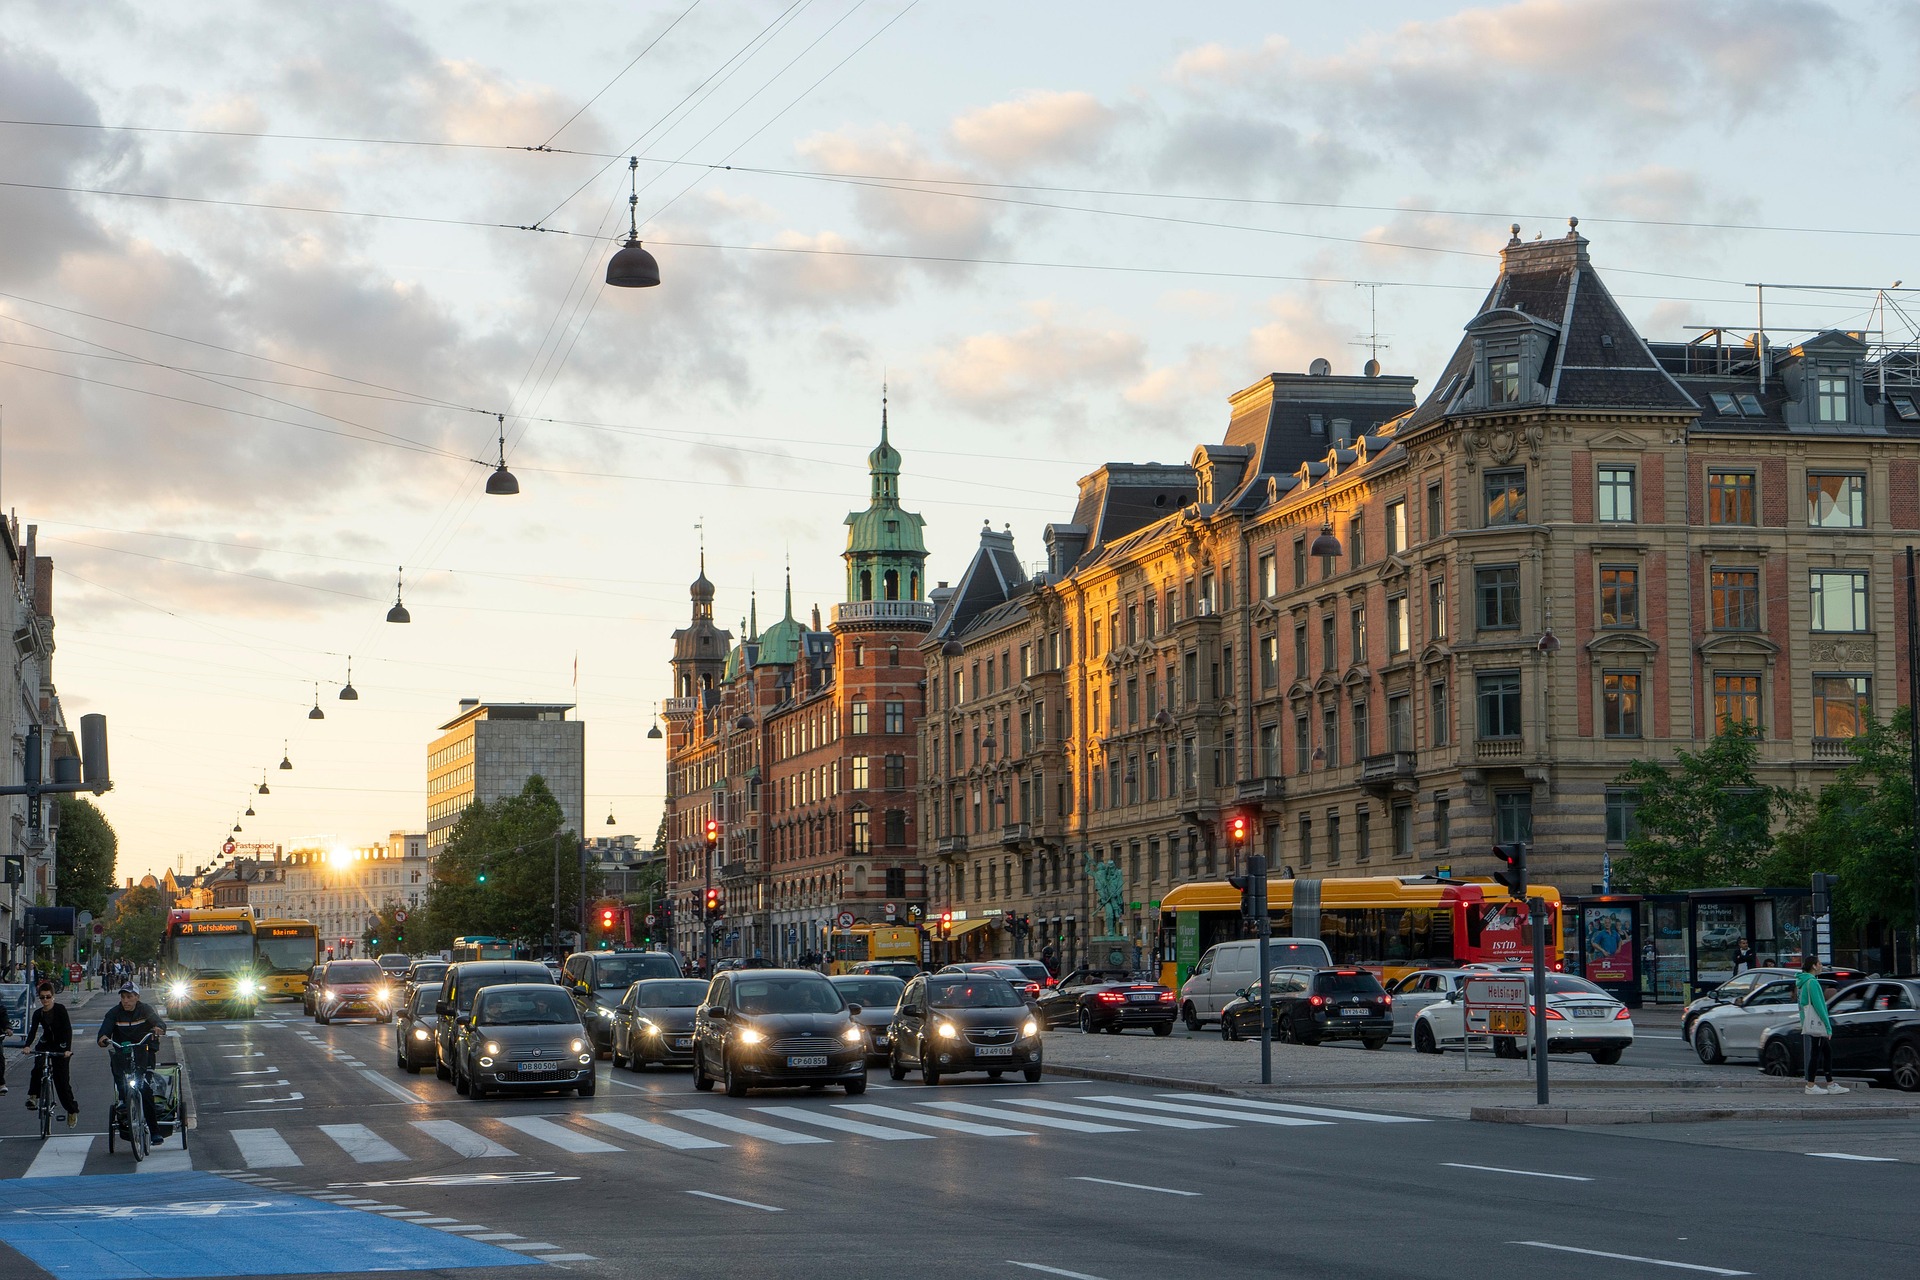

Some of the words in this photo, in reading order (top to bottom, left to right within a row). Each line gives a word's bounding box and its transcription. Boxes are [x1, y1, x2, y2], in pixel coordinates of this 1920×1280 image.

[182, 923, 193, 934] 2A
[1488, 986, 1522, 1000] Helsingør
[1494, 1015, 1502, 1027] 16
[1512, 1015, 1520, 1028] 19
[999, 1047, 1011, 1055] 016
[543, 1062, 556, 1070] 506
[813, 1057, 826, 1065] 856
